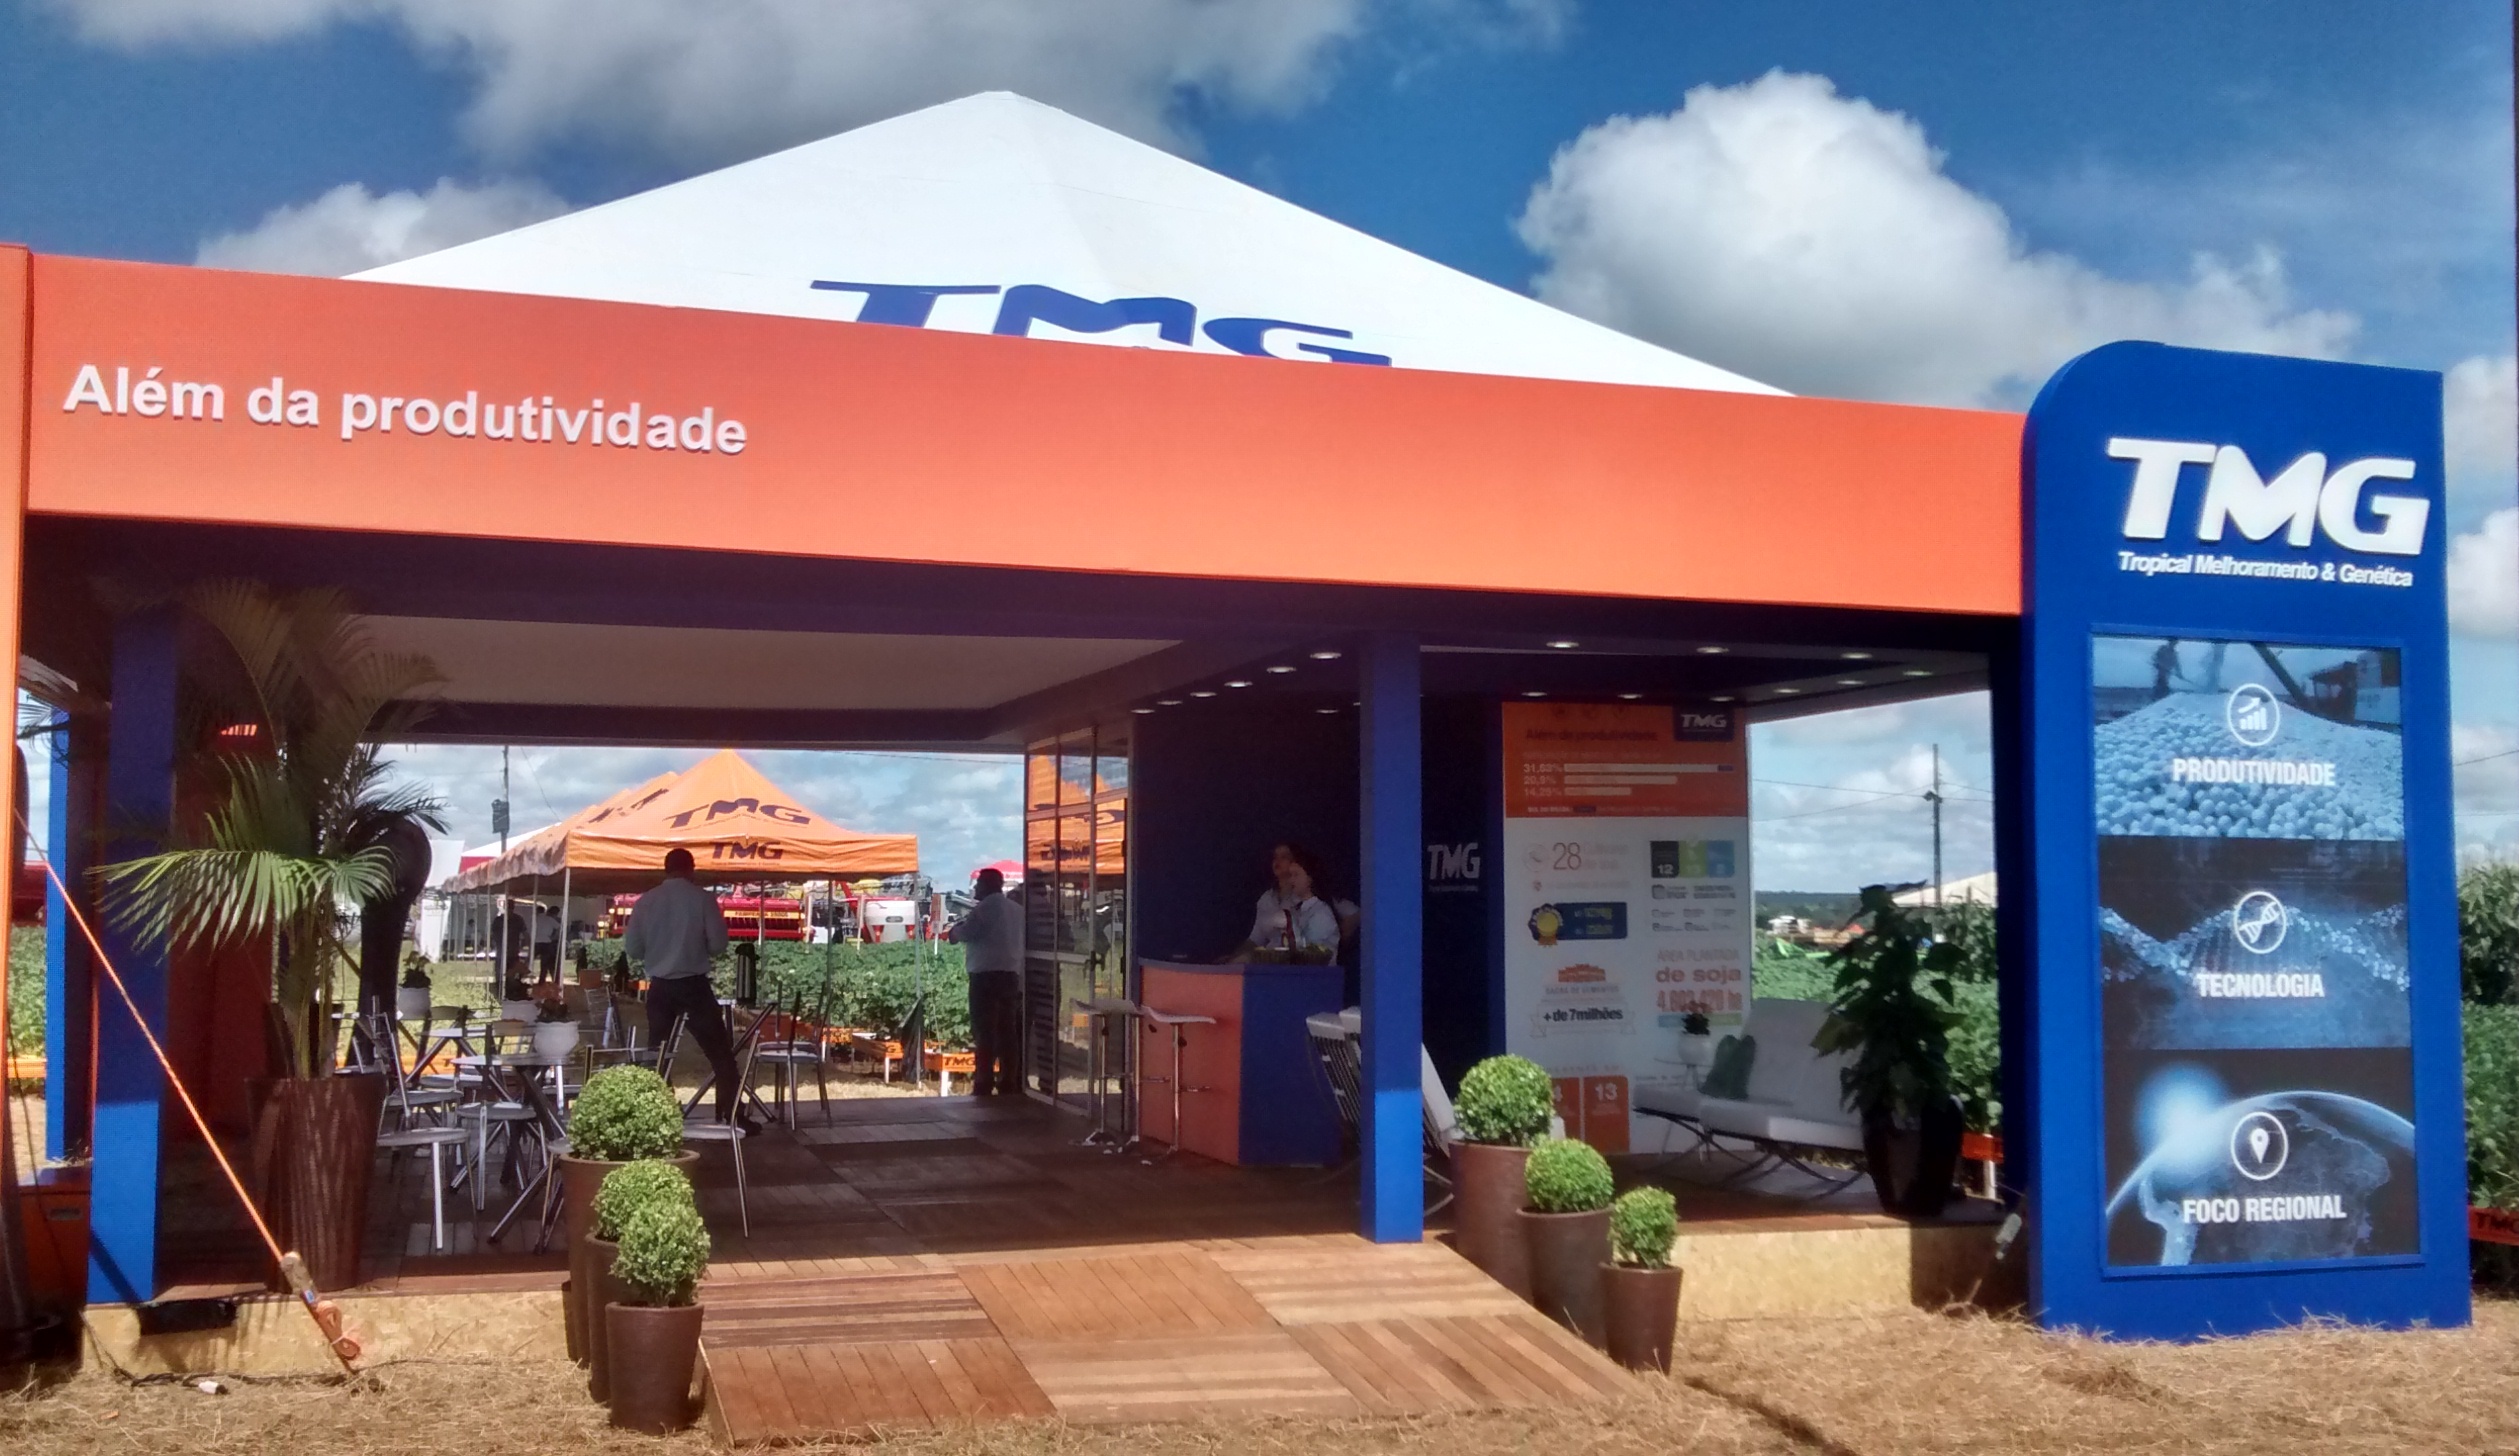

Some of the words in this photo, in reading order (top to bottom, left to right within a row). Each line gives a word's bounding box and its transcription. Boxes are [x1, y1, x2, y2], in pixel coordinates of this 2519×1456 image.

[810, 280, 1392, 366] TMG
[62, 363, 225, 421] Além
[246, 376, 319, 428] da
[340, 391, 748, 455] produtividade
[2107, 437, 2430, 556] TMG
[2118, 551, 2193, 577] Tropical
[2194, 555, 2319, 581] Melhoramento
[2320, 563, 2336, 582] &
[2339, 563, 2413, 587] Genética
[1681, 713, 1727, 728] TMG
[2173, 757, 2336, 787] PRODUTIVIDADE
[662, 797, 811, 829] TMG
[709, 842, 784, 860] TMG
[1427, 842, 1480, 880] TMG
[1552, 842, 1582, 870] 28
[1657, 863, 1675, 875] 12
[1656, 966, 1685, 982] de
[1693, 965, 1742, 984] soja
[2197, 972, 2325, 999] TECNOLOGIA
[1594, 1082, 1618, 1101] 13
[2183, 1198, 2240, 1224] FOCO
[2245, 1195, 2347, 1222] REGIONAL
